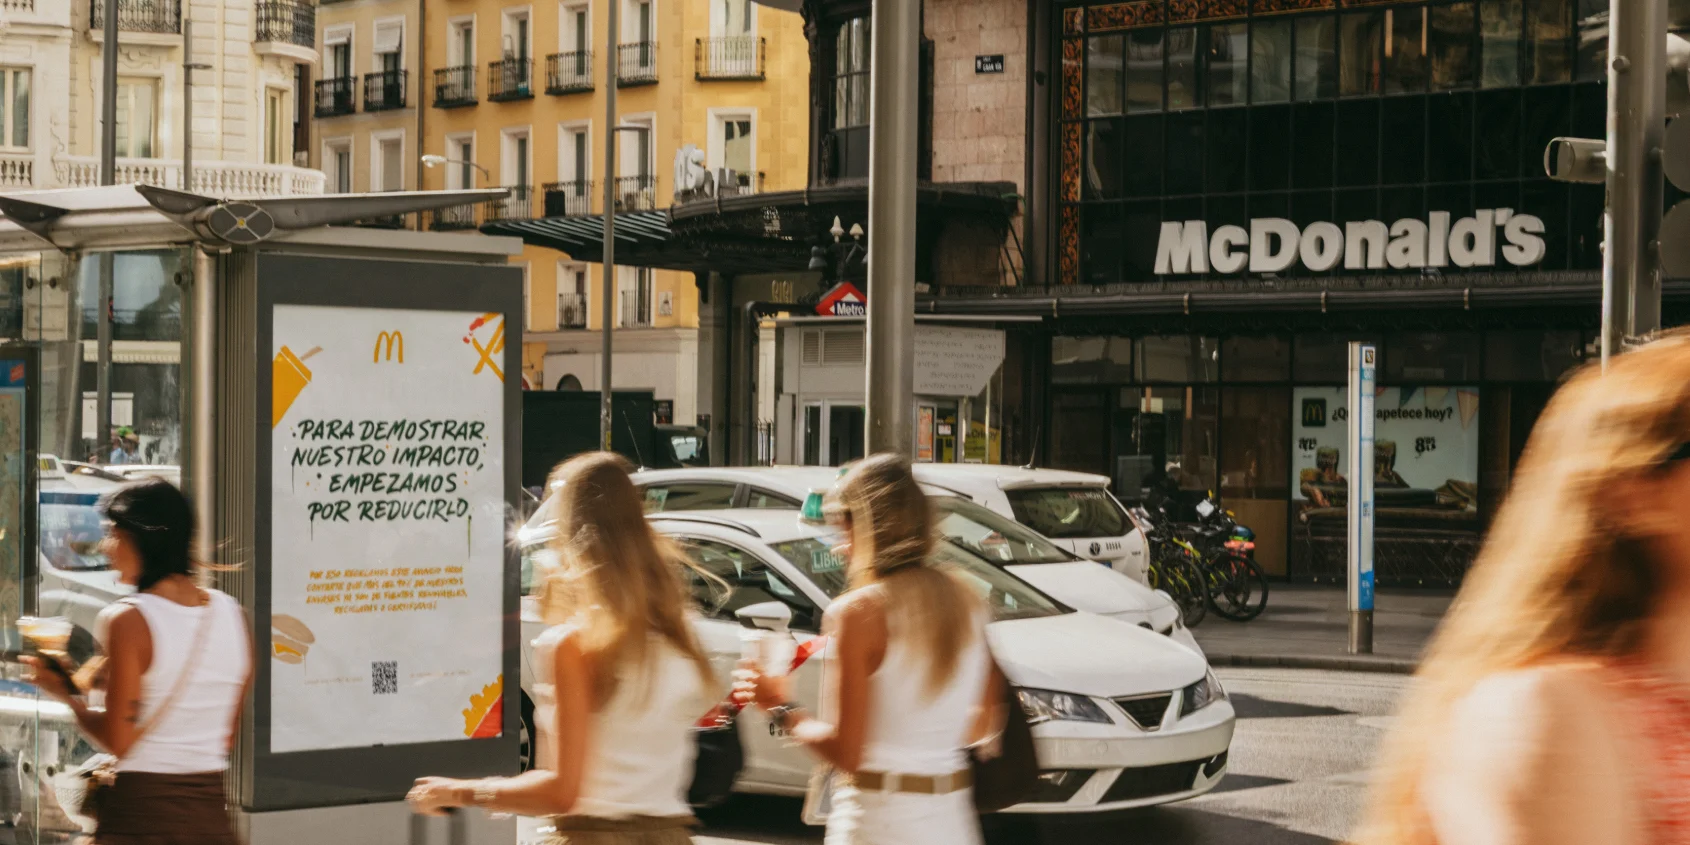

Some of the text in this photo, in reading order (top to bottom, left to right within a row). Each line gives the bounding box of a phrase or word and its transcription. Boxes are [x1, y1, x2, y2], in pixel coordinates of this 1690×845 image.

[1154, 207, 1546, 275] McDonald's
[836, 302, 864, 316] Metro
[1375, 408, 1423, 421] apetece
[1425, 406, 1453, 422] hoy?
[297, 418, 486, 442] PARA DEMOSTRAR
[291, 444, 485, 472] NUESTRO IMPACTO,
[328, 471, 457, 495] EMPEZAMOS
[307, 499, 351, 523] POR
[812, 551, 846, 569] LIBRE
